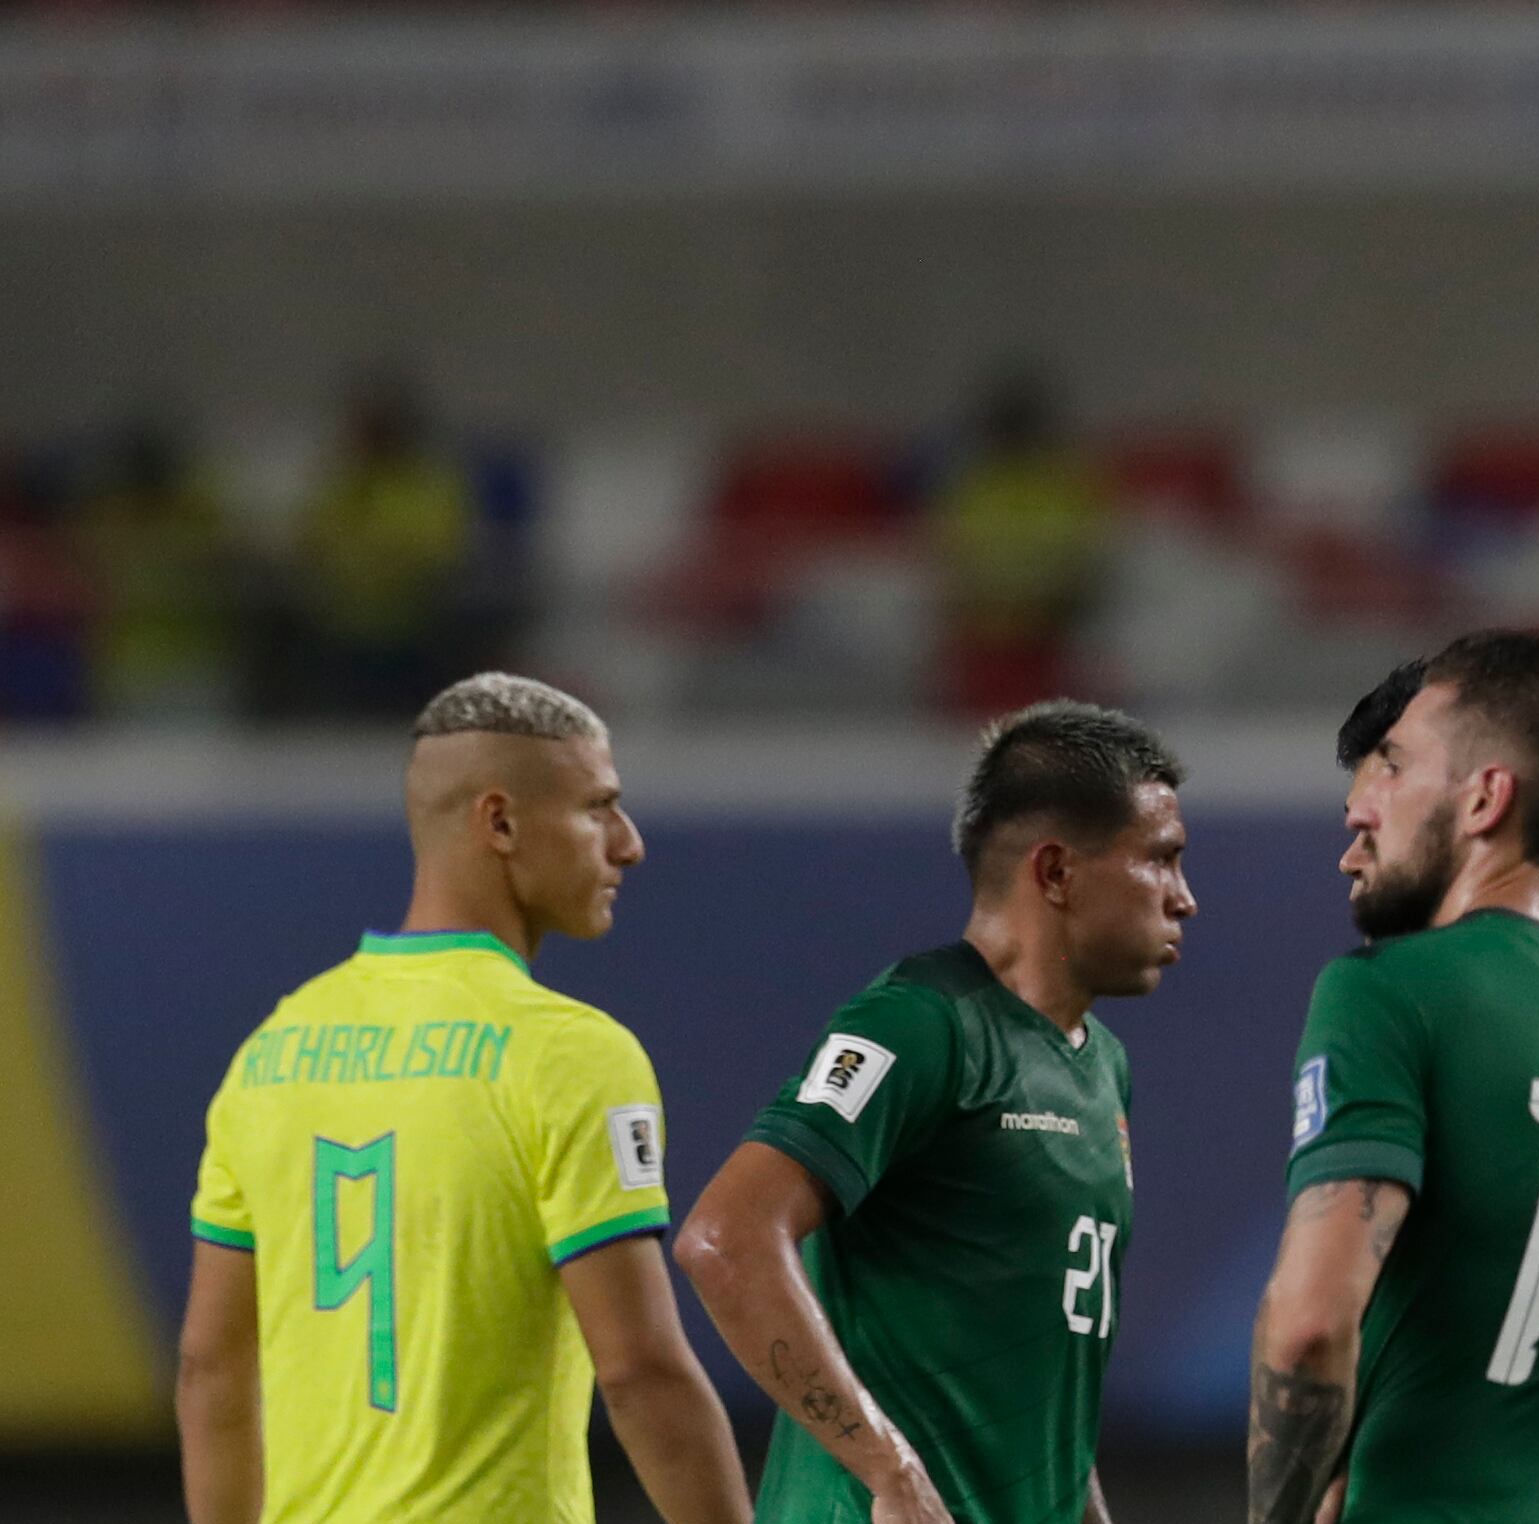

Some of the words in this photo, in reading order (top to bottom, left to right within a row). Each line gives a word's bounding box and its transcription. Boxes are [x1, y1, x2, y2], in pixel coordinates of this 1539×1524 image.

[242, 1019, 512, 1089] RICHARLISON
[1001, 1112, 1080, 1135] marathon
[313, 1131, 397, 1413] 9
[1062, 1215, 1118, 1339] 21
